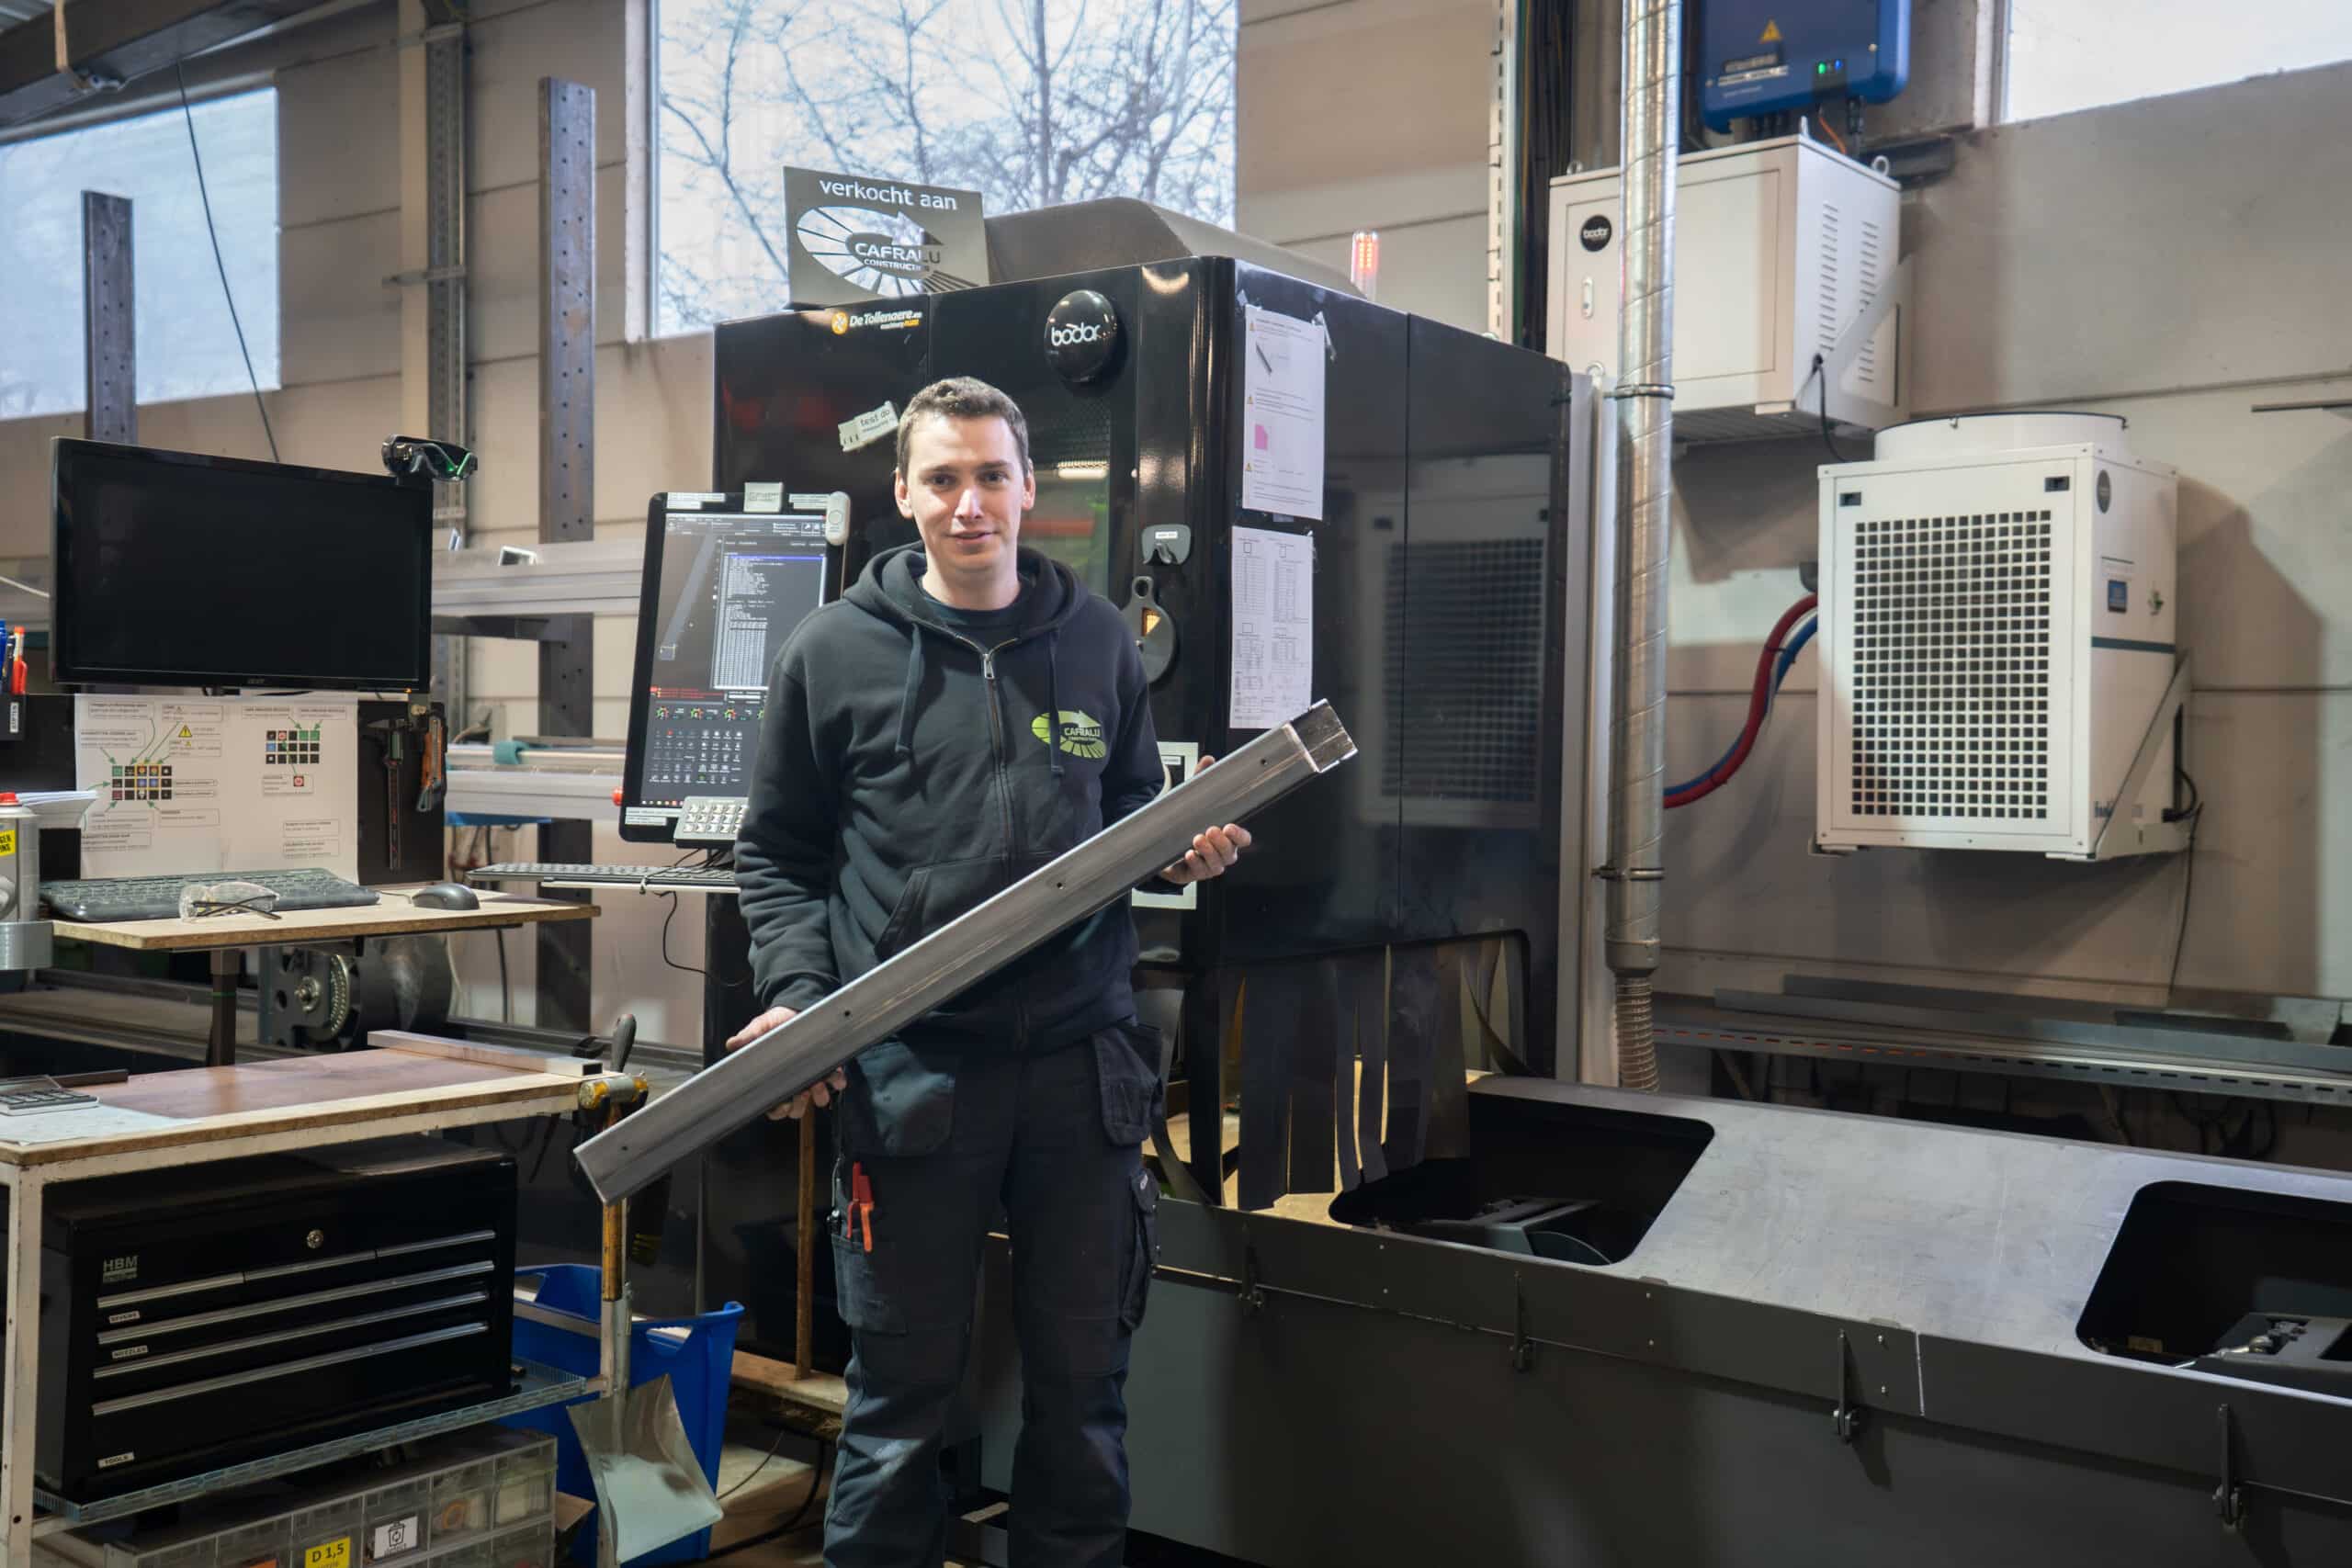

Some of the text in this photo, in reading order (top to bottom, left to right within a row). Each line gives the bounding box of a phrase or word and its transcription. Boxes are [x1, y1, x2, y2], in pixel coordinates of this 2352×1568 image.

[819, 180, 957, 211] verkocht aan
[854, 243, 941, 264] CAFRALU
[1051, 321, 1101, 346] bodor
[1064, 727, 1100, 737] CAFRALU
[103, 1255, 138, 1272] HBM
[312, 1542, 345, 1562] D 1,5
